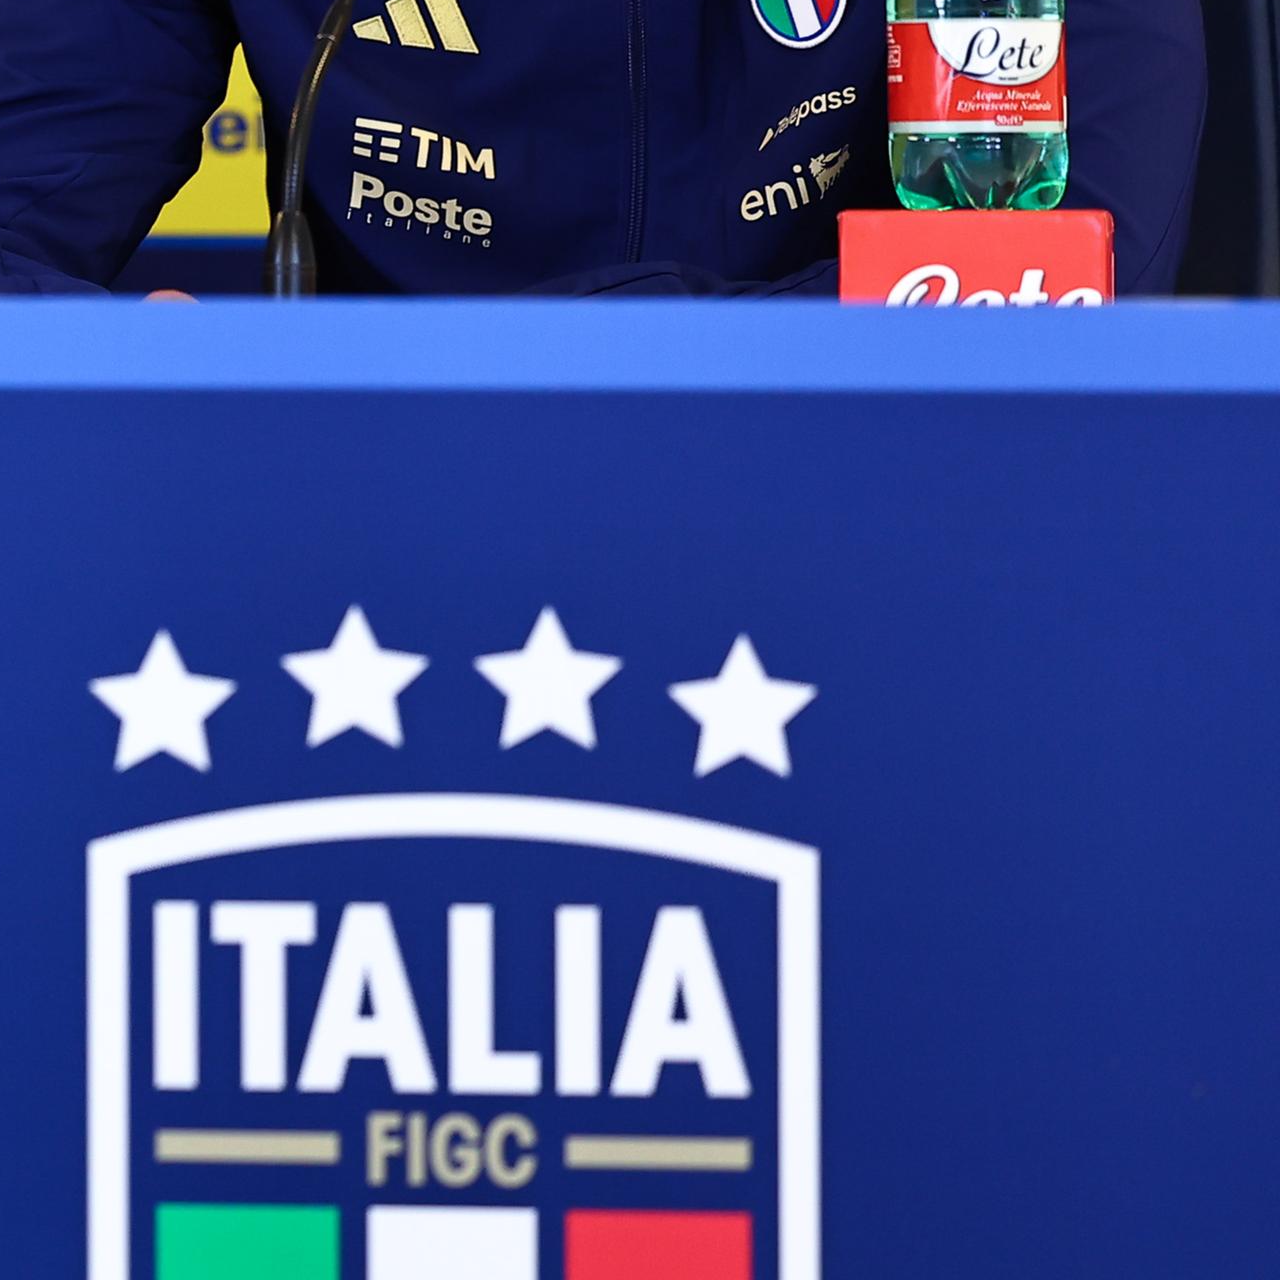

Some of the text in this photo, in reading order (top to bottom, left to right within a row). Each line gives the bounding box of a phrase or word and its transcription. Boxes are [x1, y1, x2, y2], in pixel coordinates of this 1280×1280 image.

[953, 26, 1044, 79] Lete
[411, 127, 496, 180] TIM
[349, 171, 493, 236] Poste
[741, 164, 810, 222] eni
[153, 900, 753, 1099] ITALIA
[366, 1111, 538, 1188] FIGC
